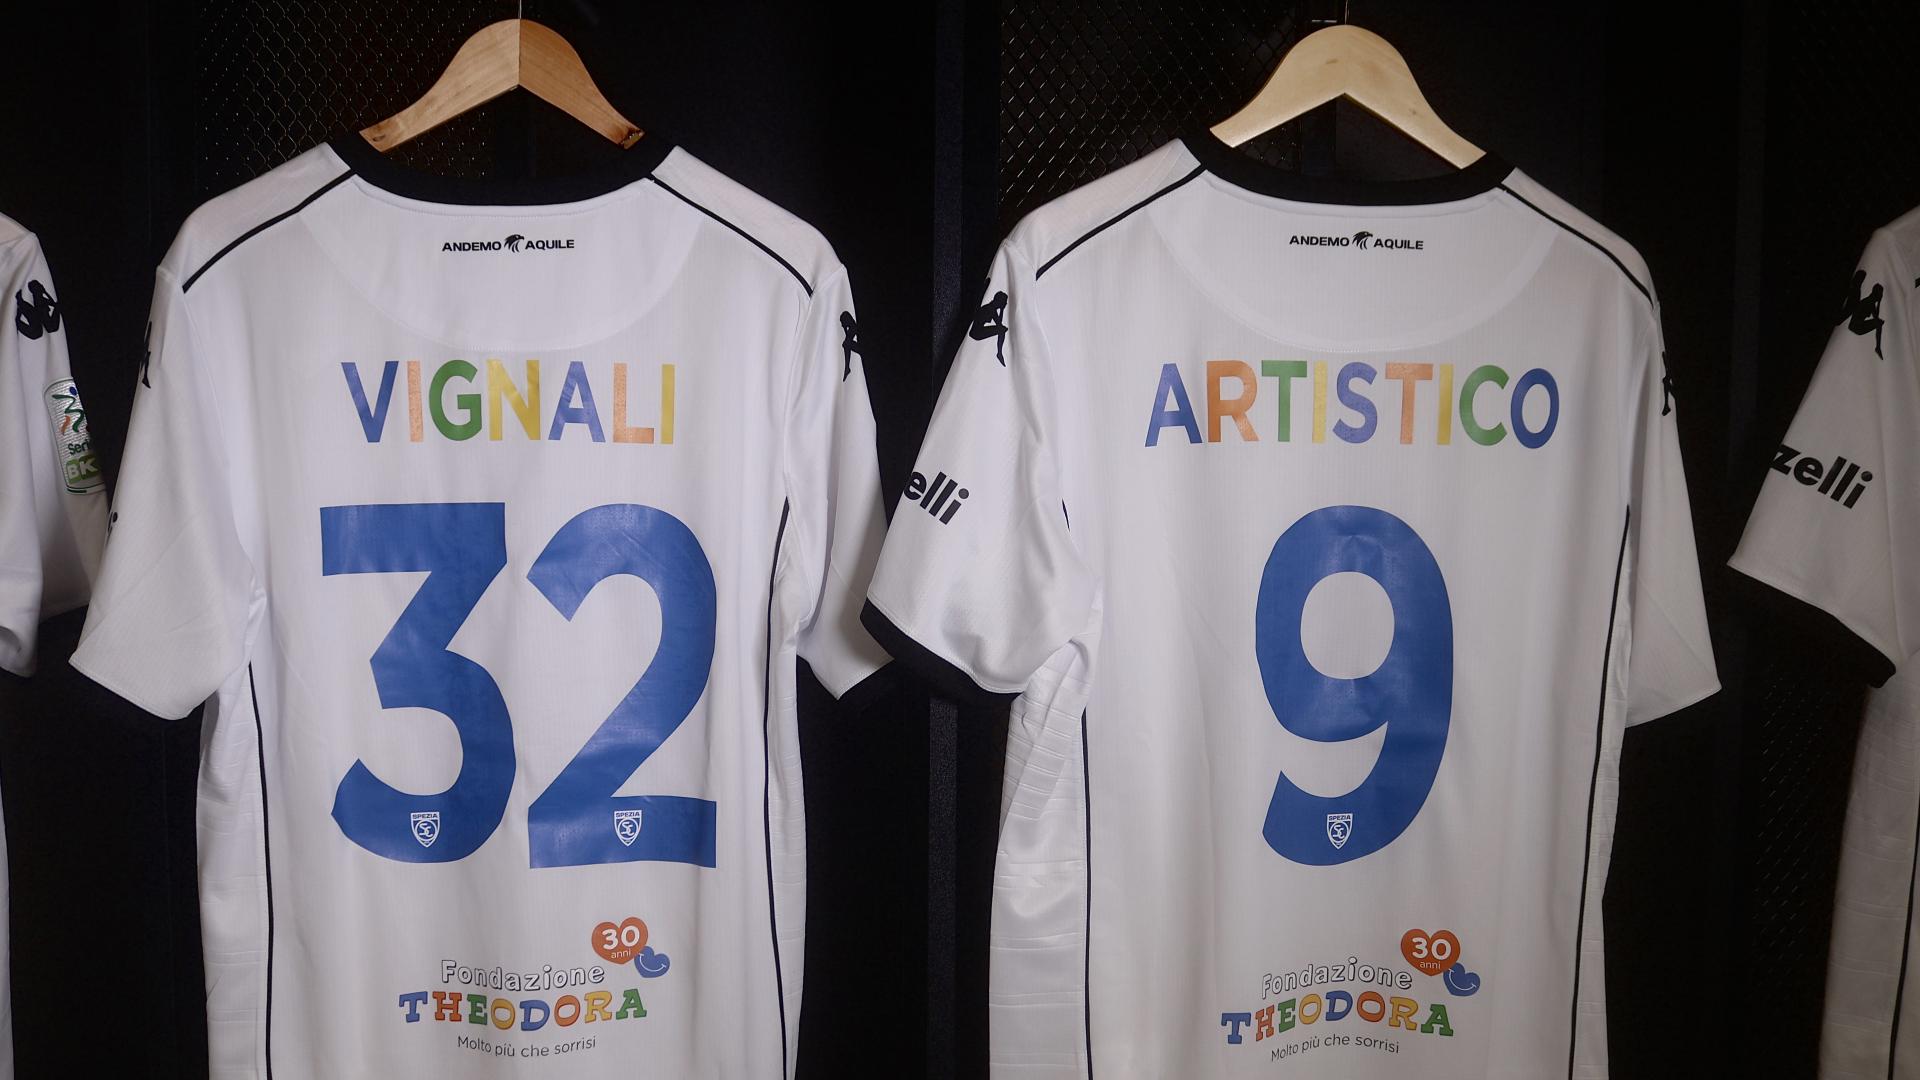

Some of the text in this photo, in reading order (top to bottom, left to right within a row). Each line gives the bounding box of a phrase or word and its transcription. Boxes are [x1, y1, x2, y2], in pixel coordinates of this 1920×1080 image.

[442, 239, 575, 252] ANDEMO AQUILE
[1289, 235, 1424, 250] ANDEMO AQUILE
[341, 359, 676, 444] VIGNALI
[1145, 359, 1560, 449] ARTISTICO
[320, 502, 717, 869] 32
[1255, 505, 1454, 867] 9
[602, 925, 641, 950] 30
[1411, 937, 1452, 960] 30
[610, 949, 632, 959] anni
[1419, 959, 1441, 970] anni
[441, 960, 606, 991] Fondazione
[1262, 957, 1413, 1000] Fondazione
[399, 988, 648, 1031] THEODORA
[1221, 990, 1454, 1045] THEODORA
[457, 1036, 596, 1058] Molto più che sorrisi
[1271, 1032, 1400, 1062] Molto più che sorrisi
